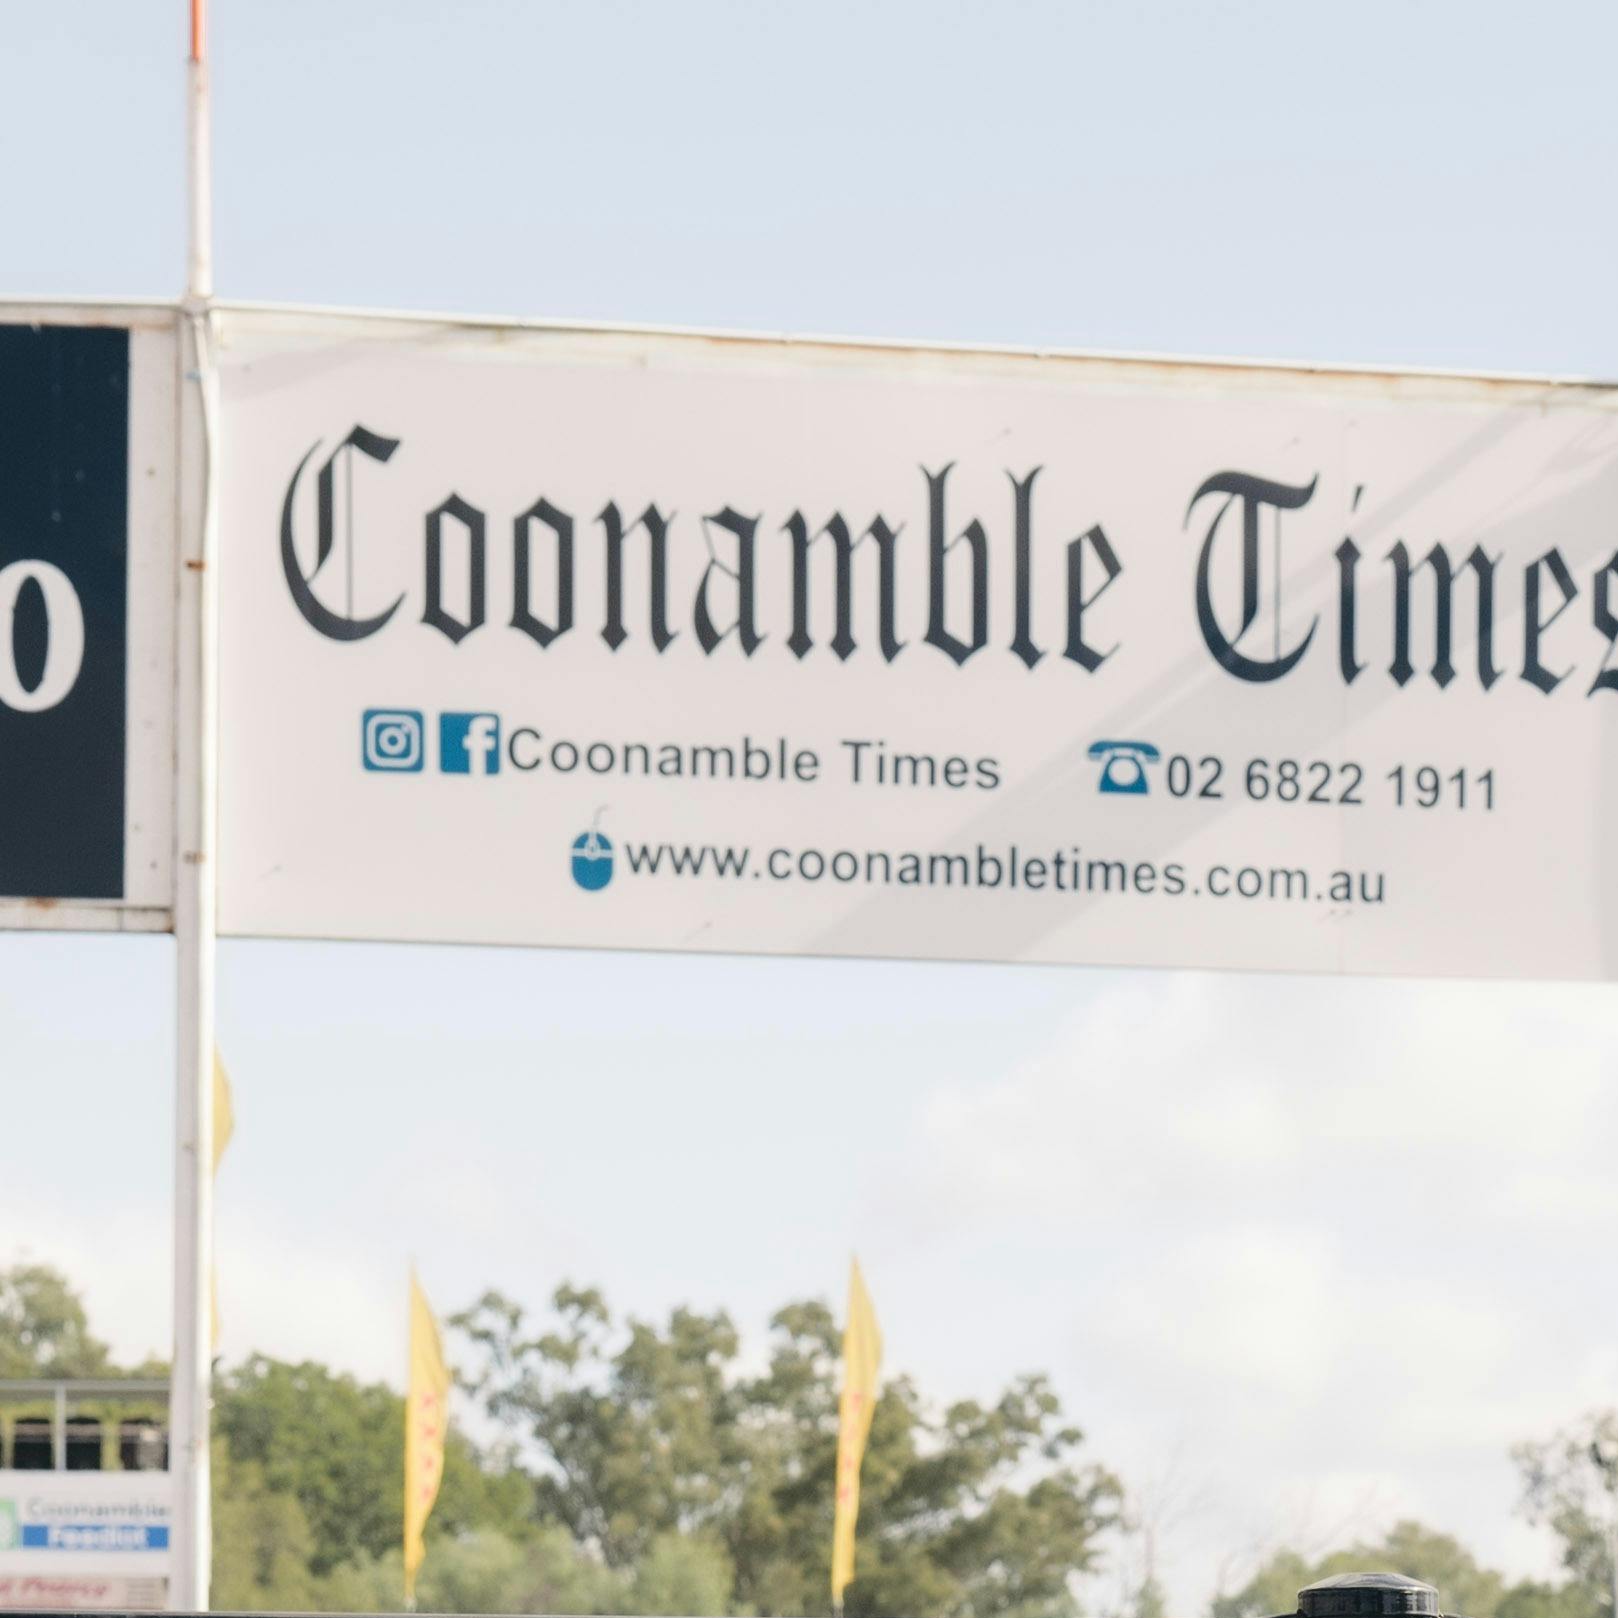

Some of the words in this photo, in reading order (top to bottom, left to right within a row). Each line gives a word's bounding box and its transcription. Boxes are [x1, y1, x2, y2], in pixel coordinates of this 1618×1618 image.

[279, 424, 1122, 674] Coonamble
[508, 728, 819, 782] Coonamble
[842, 741, 1000, 790] Times
[1167, 755, 1223, 799] 02
[1245, 758, 1362, 805] 6822
[1388, 765, 1495, 811] 1911
[626, 844, 1386, 904] www.coonambletimes.com.au
